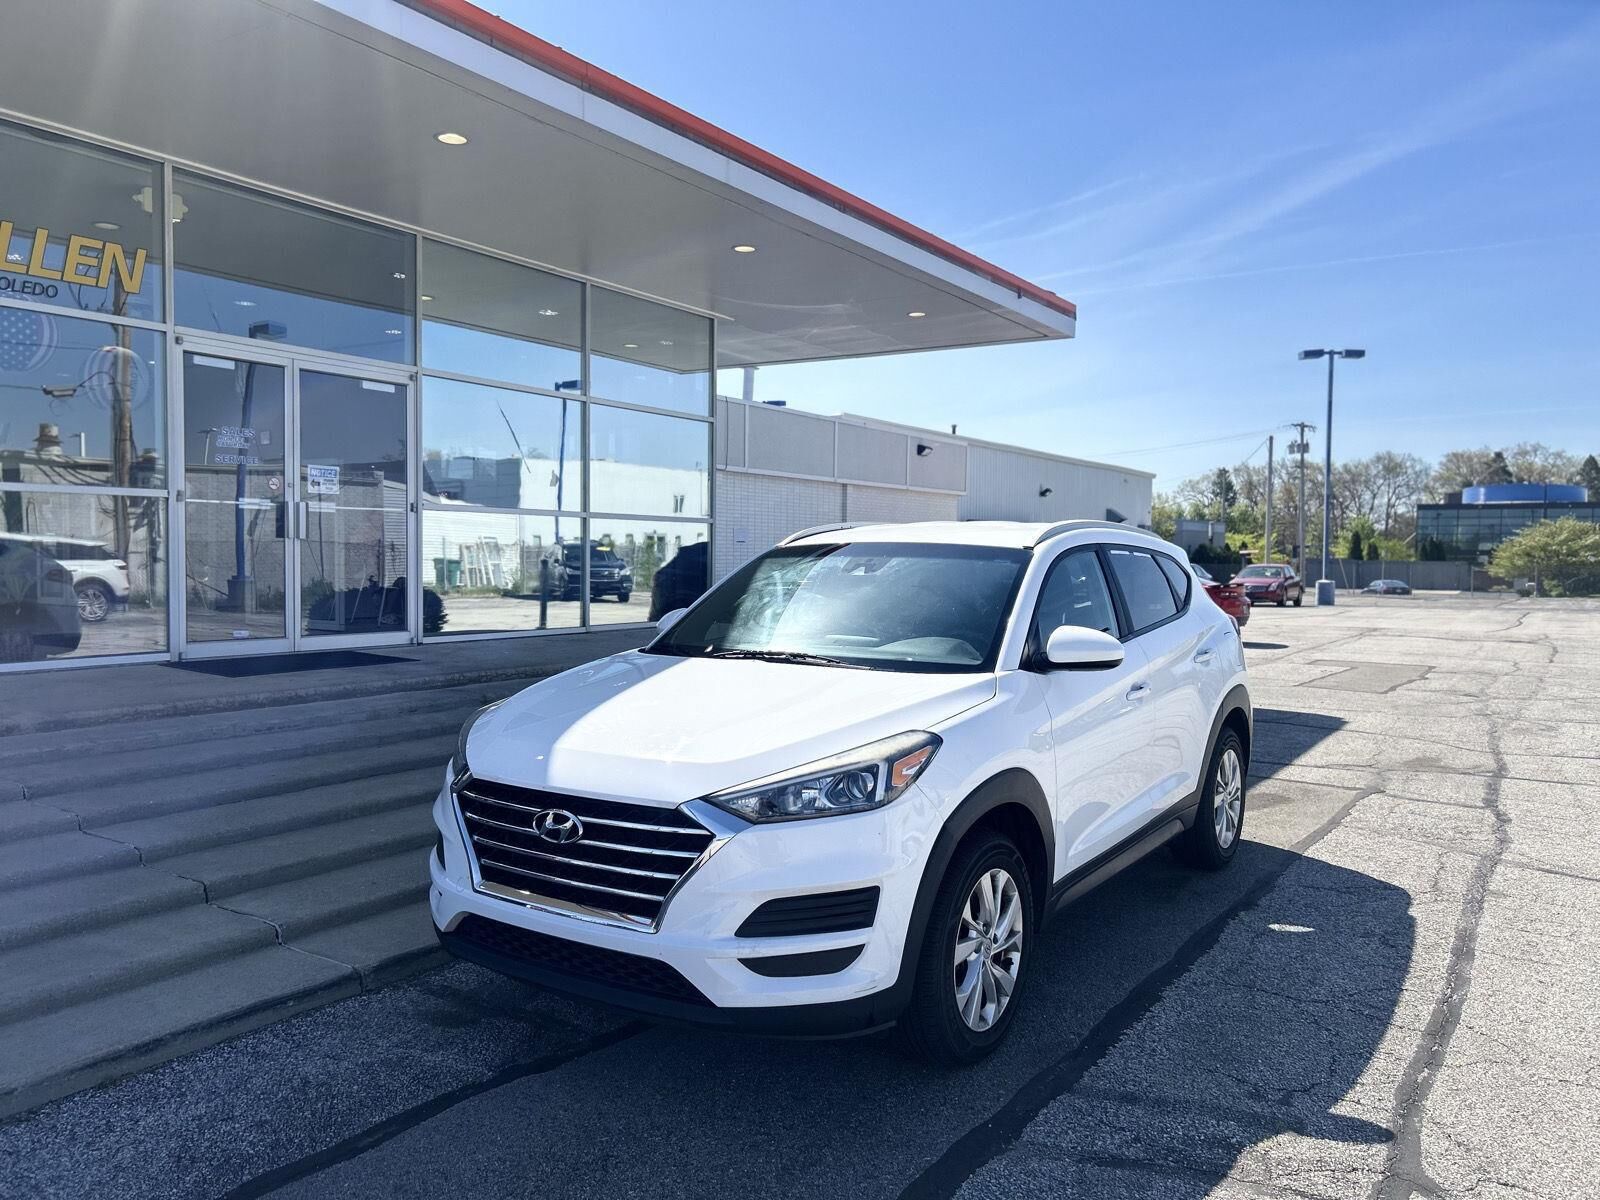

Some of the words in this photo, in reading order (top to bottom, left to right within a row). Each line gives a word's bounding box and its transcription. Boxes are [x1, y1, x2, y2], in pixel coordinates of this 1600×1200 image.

[0, 220, 147, 293] LLEN
[0, 276, 58, 299] OLEDO
[221, 426, 256, 438] SALES
[215, 454, 259, 465] SERVICE
[311, 469, 336, 477] NOTICE
